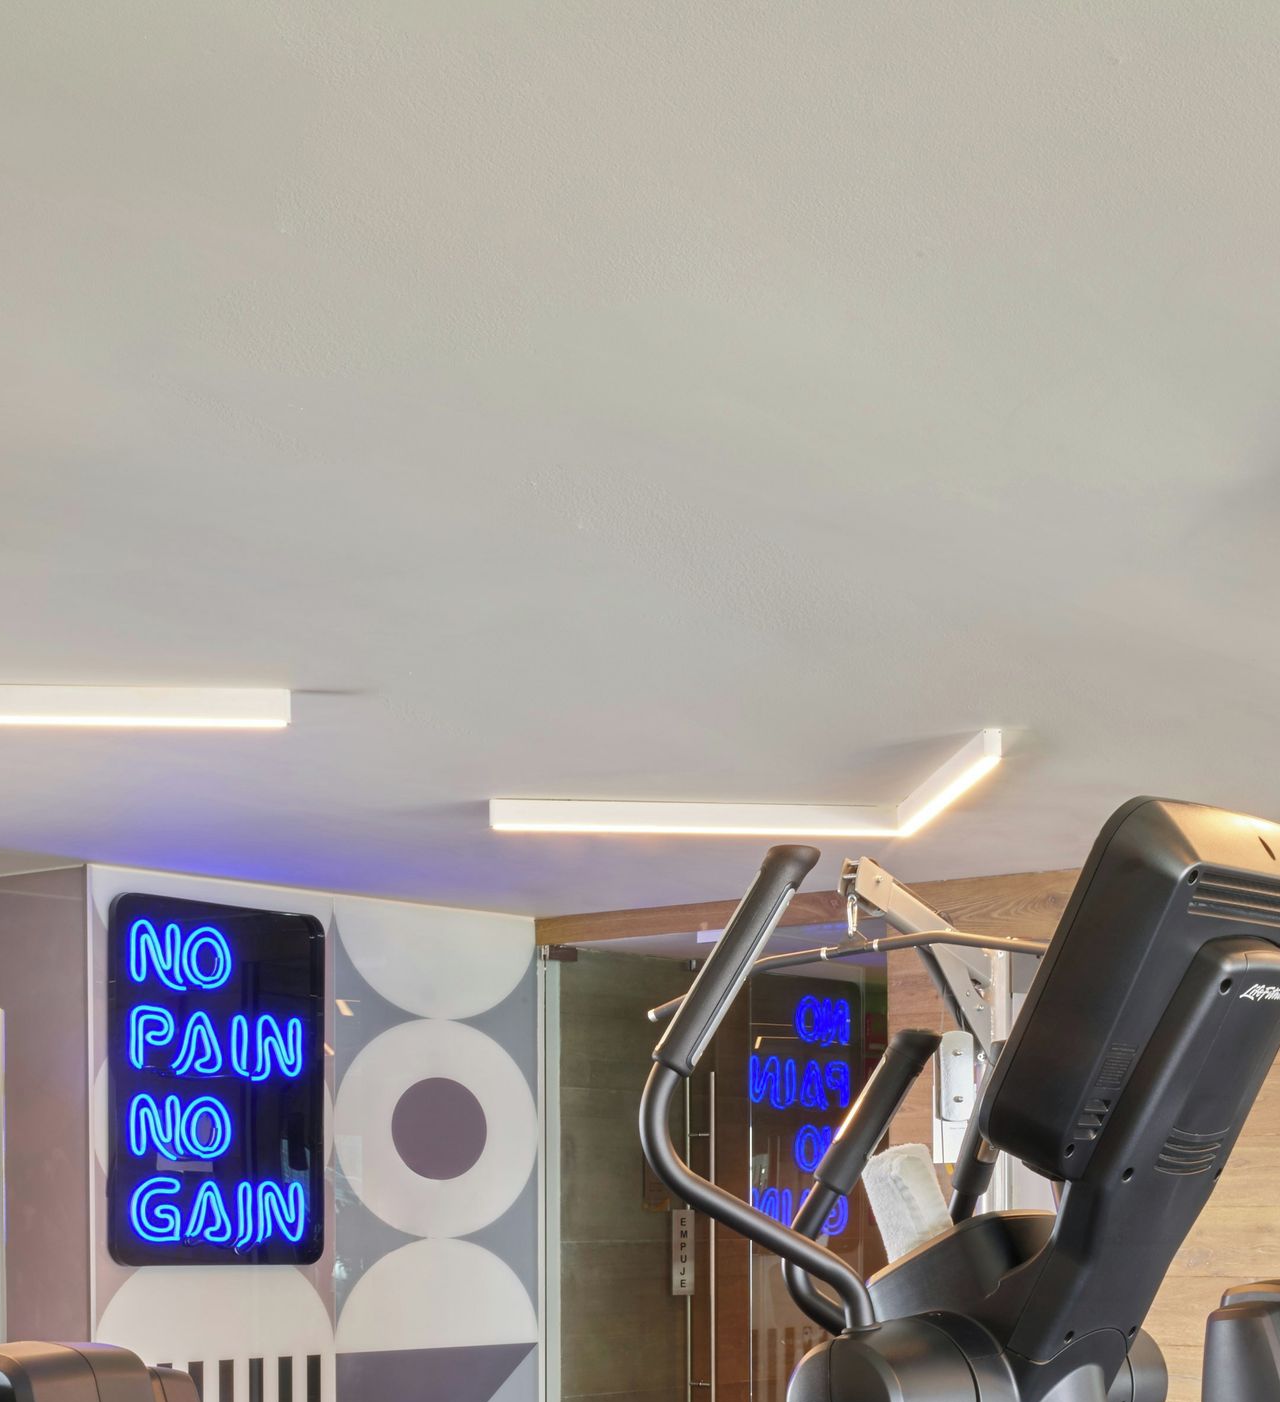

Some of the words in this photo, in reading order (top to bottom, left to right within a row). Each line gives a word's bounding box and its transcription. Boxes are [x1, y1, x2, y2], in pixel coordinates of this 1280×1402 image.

[129, 918, 232, 991] NO
[129, 1004, 303, 1081] PAIN
[129, 1093, 232, 1161] NO
[130, 1176, 306, 1248] GAIN
[679, 1217, 688, 1289] EMPUJE
